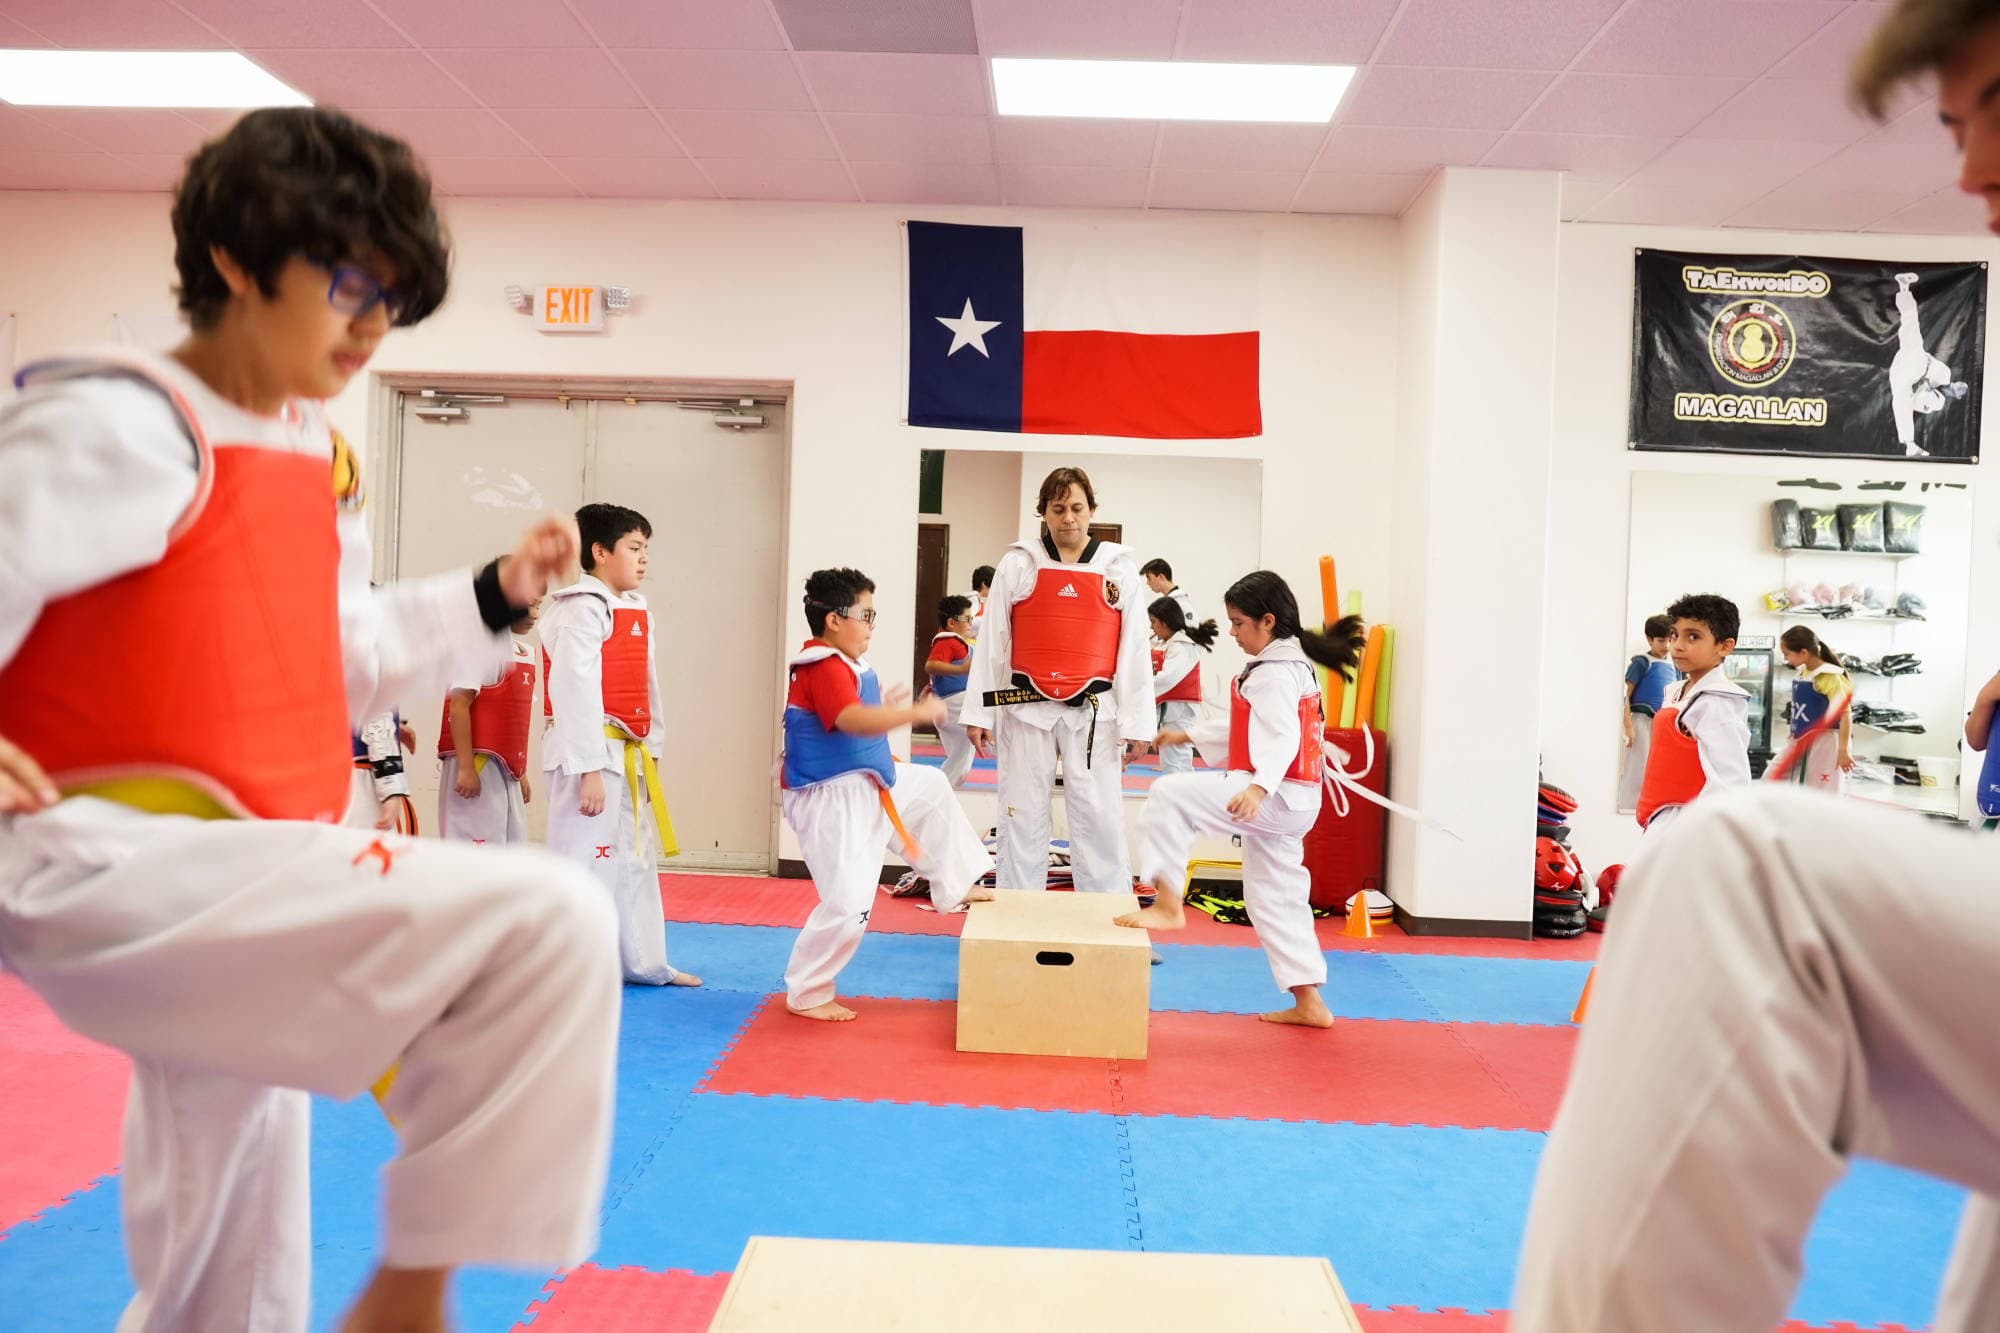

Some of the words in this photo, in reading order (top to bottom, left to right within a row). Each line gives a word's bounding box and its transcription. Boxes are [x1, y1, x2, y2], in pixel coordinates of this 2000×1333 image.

[545, 287, 593, 324] EXIT
[1735, 371, 1774, 382] MAGALLAN
[1679, 397, 1822, 421] MAGALLAN
[1053, 687, 1060, 696] 4
